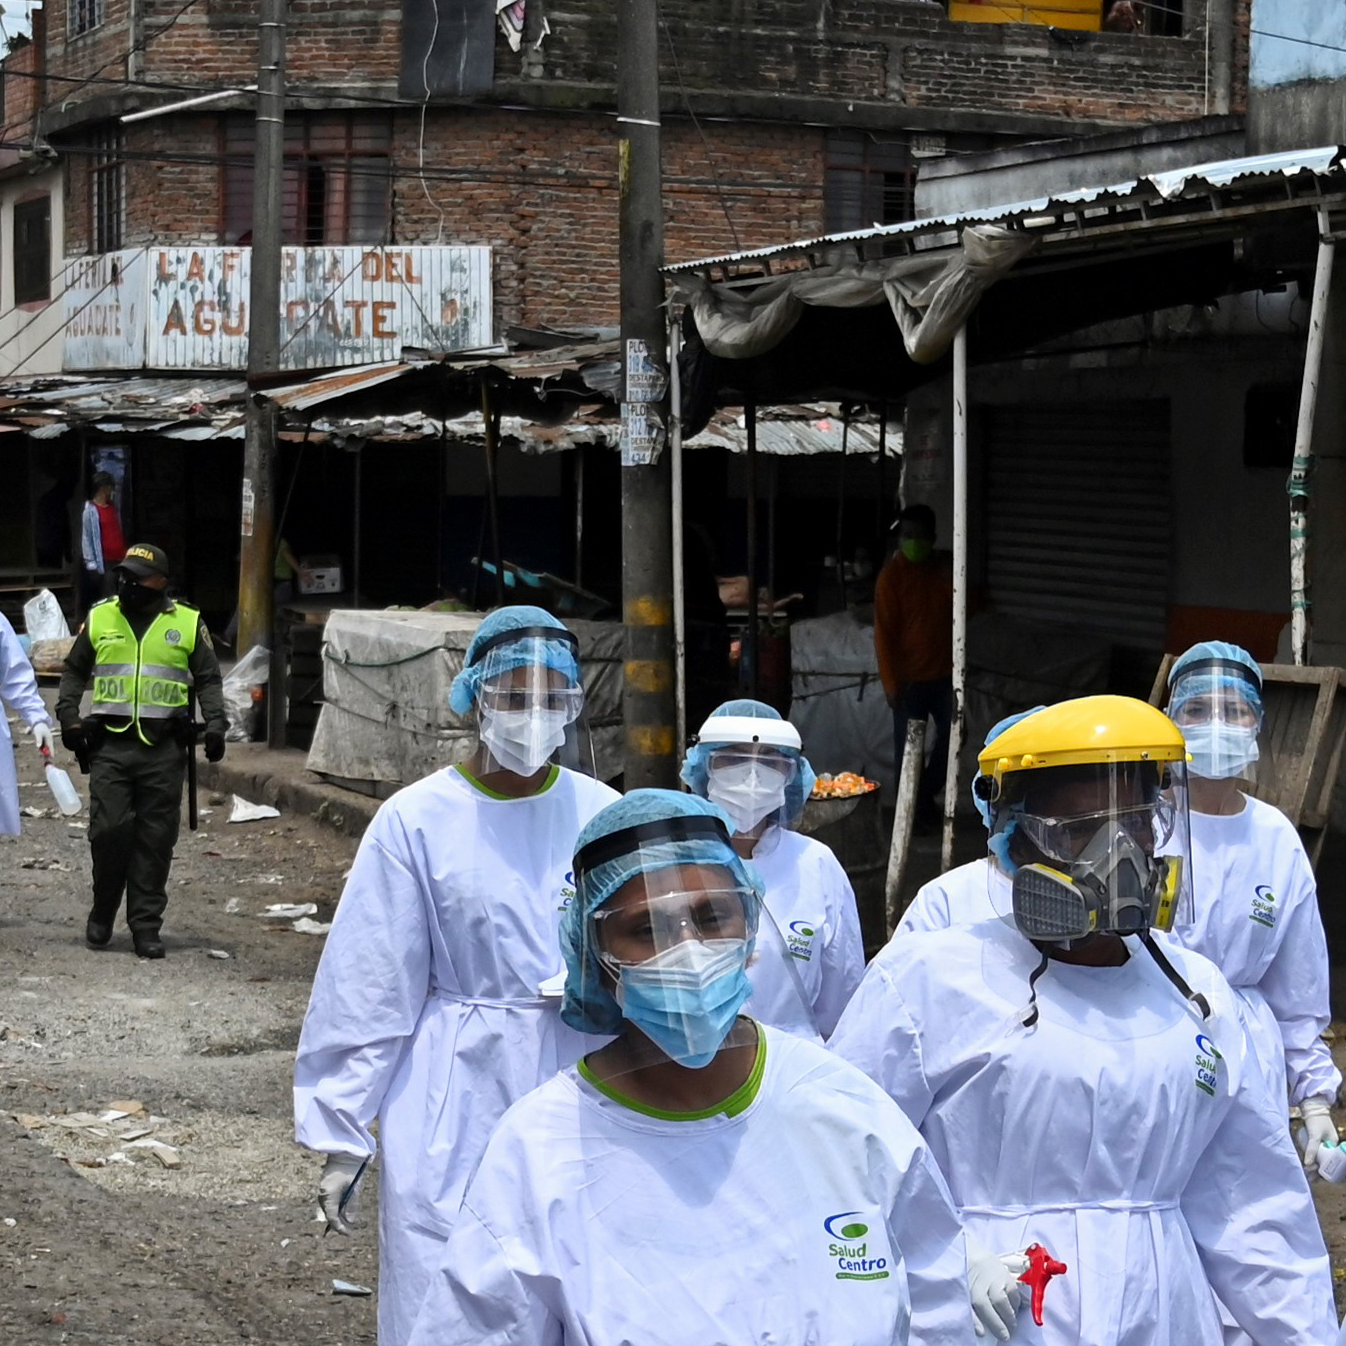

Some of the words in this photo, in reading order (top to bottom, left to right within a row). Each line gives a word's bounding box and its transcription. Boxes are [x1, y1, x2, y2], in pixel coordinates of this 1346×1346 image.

[158, 251, 206, 283] LA
[222, 251, 345, 284] FRIA
[361, 251, 423, 284] DEL
[161, 298, 398, 340] AGUCATE
[1195, 1055, 1217, 1074] Salu
[828, 1242, 867, 1258] Salud
[838, 1257, 887, 1272] Centro
